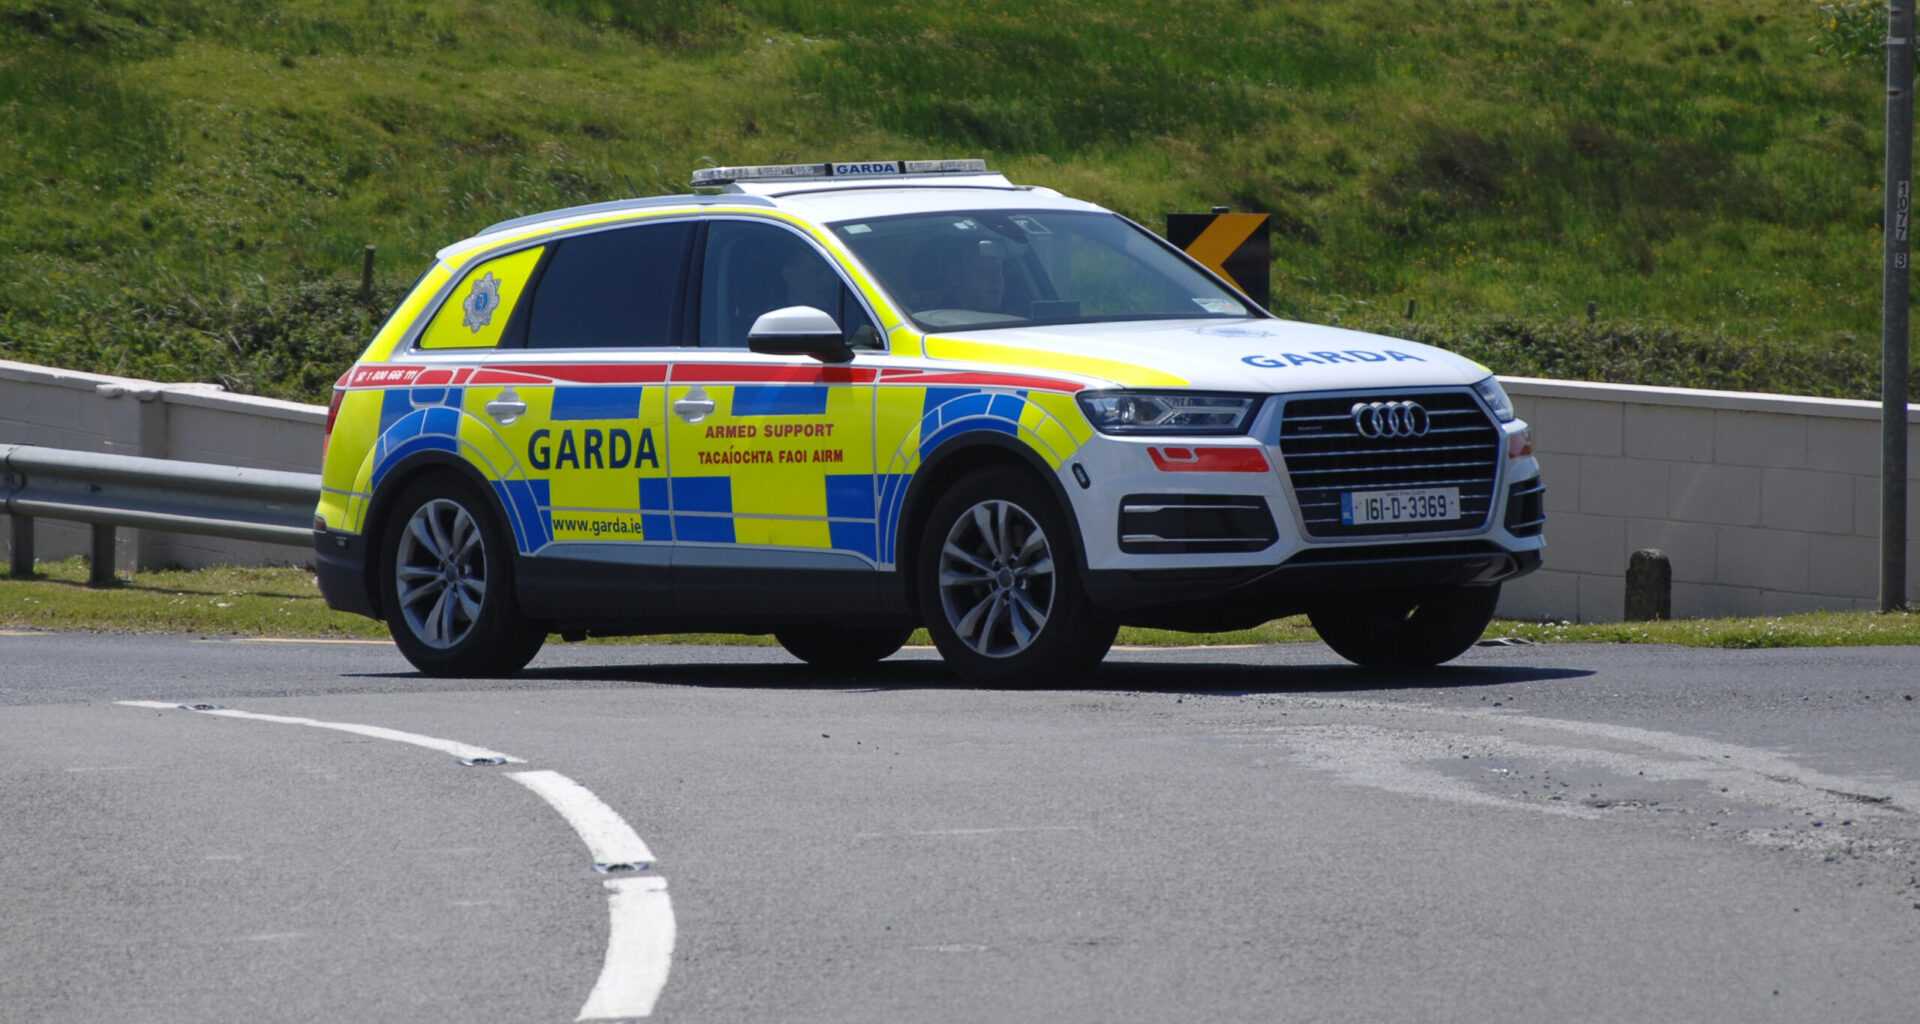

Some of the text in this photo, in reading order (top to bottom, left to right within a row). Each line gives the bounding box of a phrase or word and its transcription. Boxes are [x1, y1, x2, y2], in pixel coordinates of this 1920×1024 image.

[836, 163, 895, 174] GARDA
[1897, 182, 1907, 240] 1077
[1241, 350, 1428, 368] GARDA
[705, 424, 834, 438] ARMED SUPPORT
[528, 428, 659, 470] GARDA
[698, 445, 843, 464] TACAÍOCHTA FAOI AIRM
[1366, 495, 1447, 520] 161-D-3369
[552, 517, 642, 536] www.garda.ie
